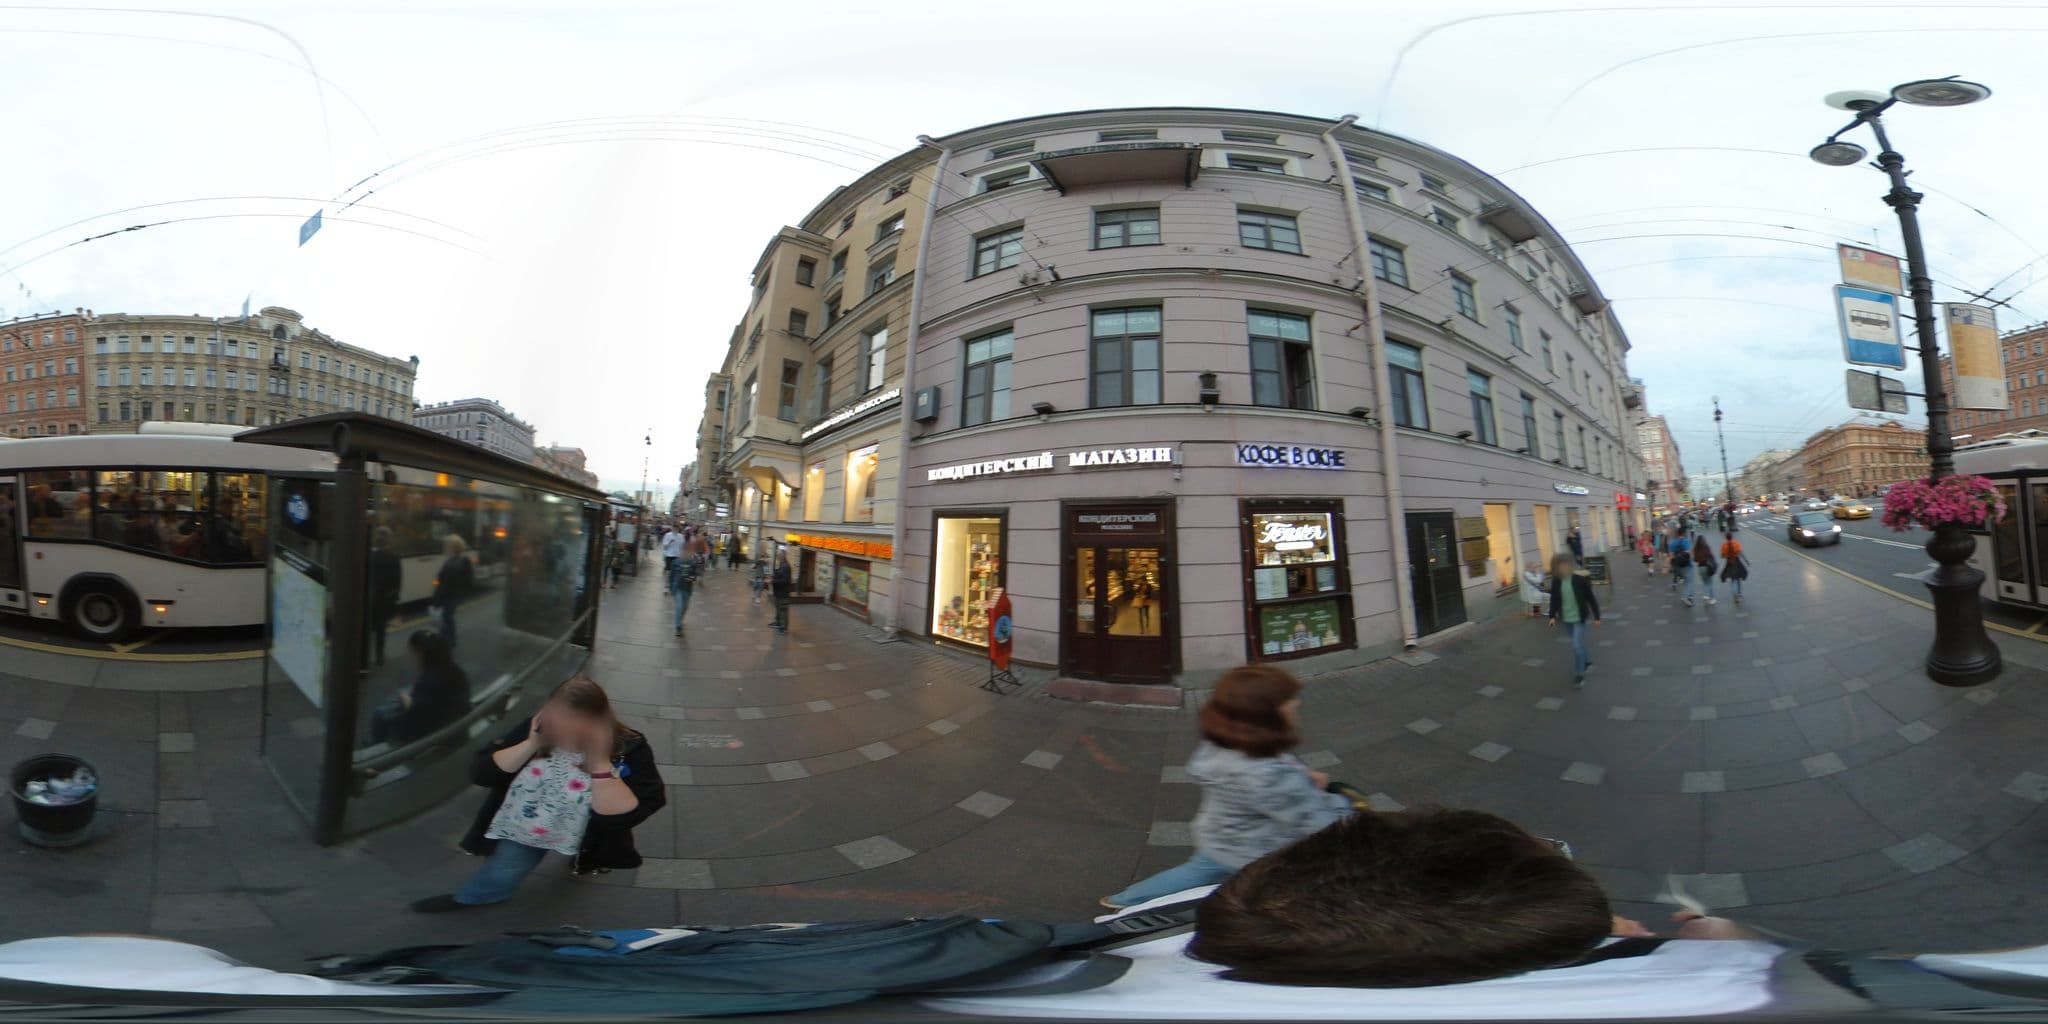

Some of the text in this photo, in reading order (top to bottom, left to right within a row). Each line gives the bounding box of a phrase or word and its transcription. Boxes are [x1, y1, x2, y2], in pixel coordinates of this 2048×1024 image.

[928, 447, 1172, 481] КОНДИТЕРСКИЙ МАГАЗИН
[1236, 444, 1345, 467] КОФЕ В ОКНЕ
